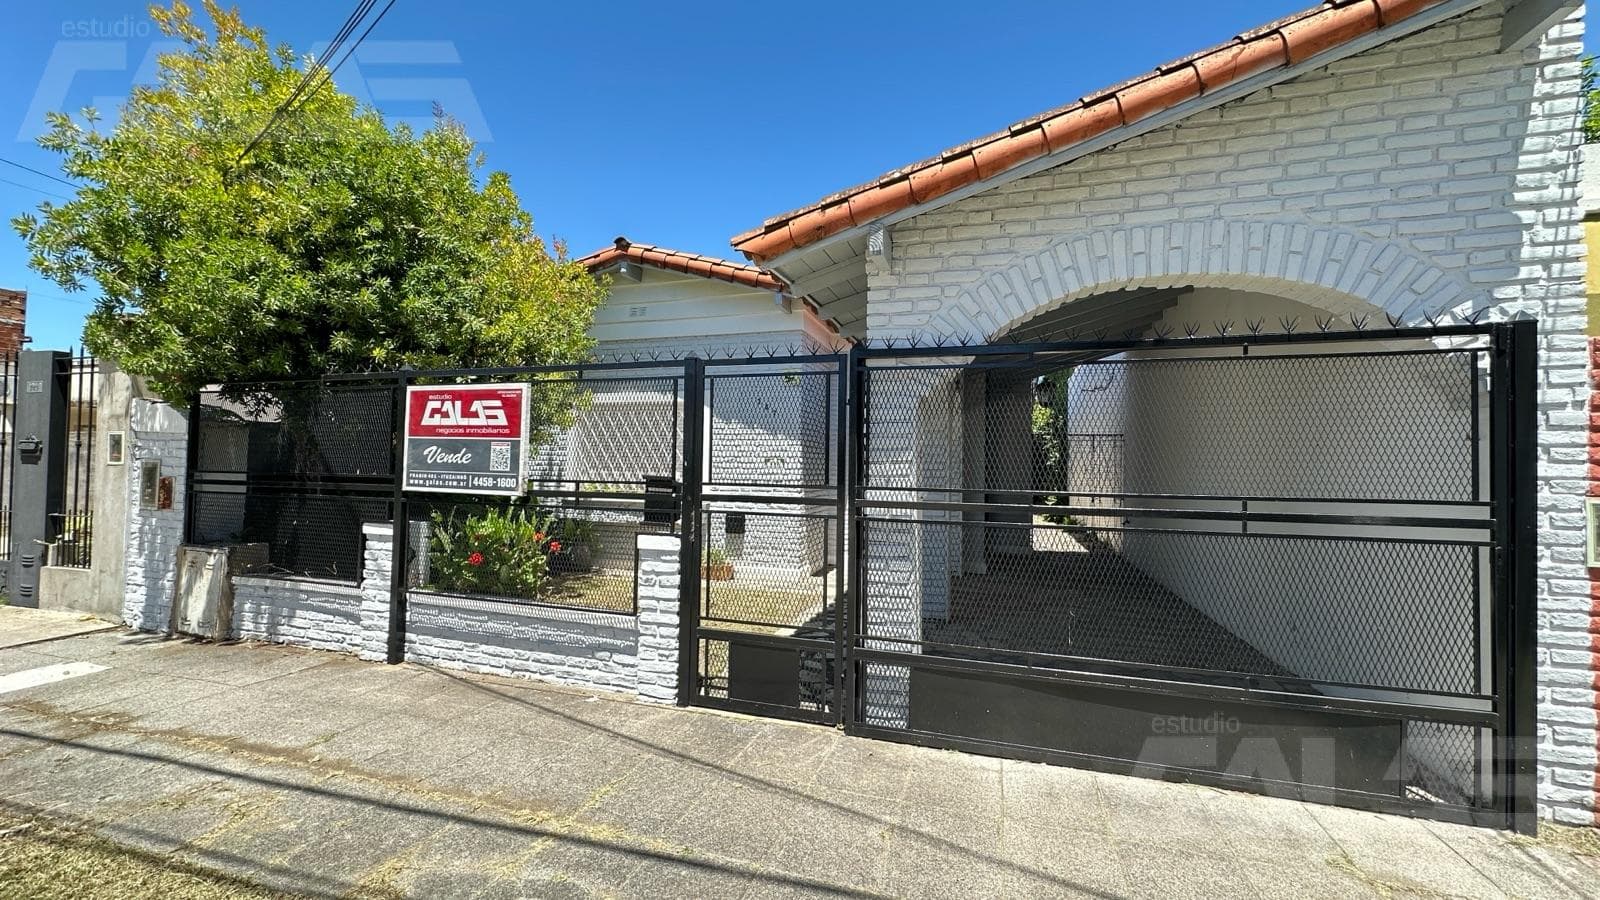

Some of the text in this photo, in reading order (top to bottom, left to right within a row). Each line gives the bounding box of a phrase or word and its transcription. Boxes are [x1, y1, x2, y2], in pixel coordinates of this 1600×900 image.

[420, 400, 509, 426] GALAS
[423, 445, 472, 464] Vende
[472, 477, 517, 488] 4458-1600
